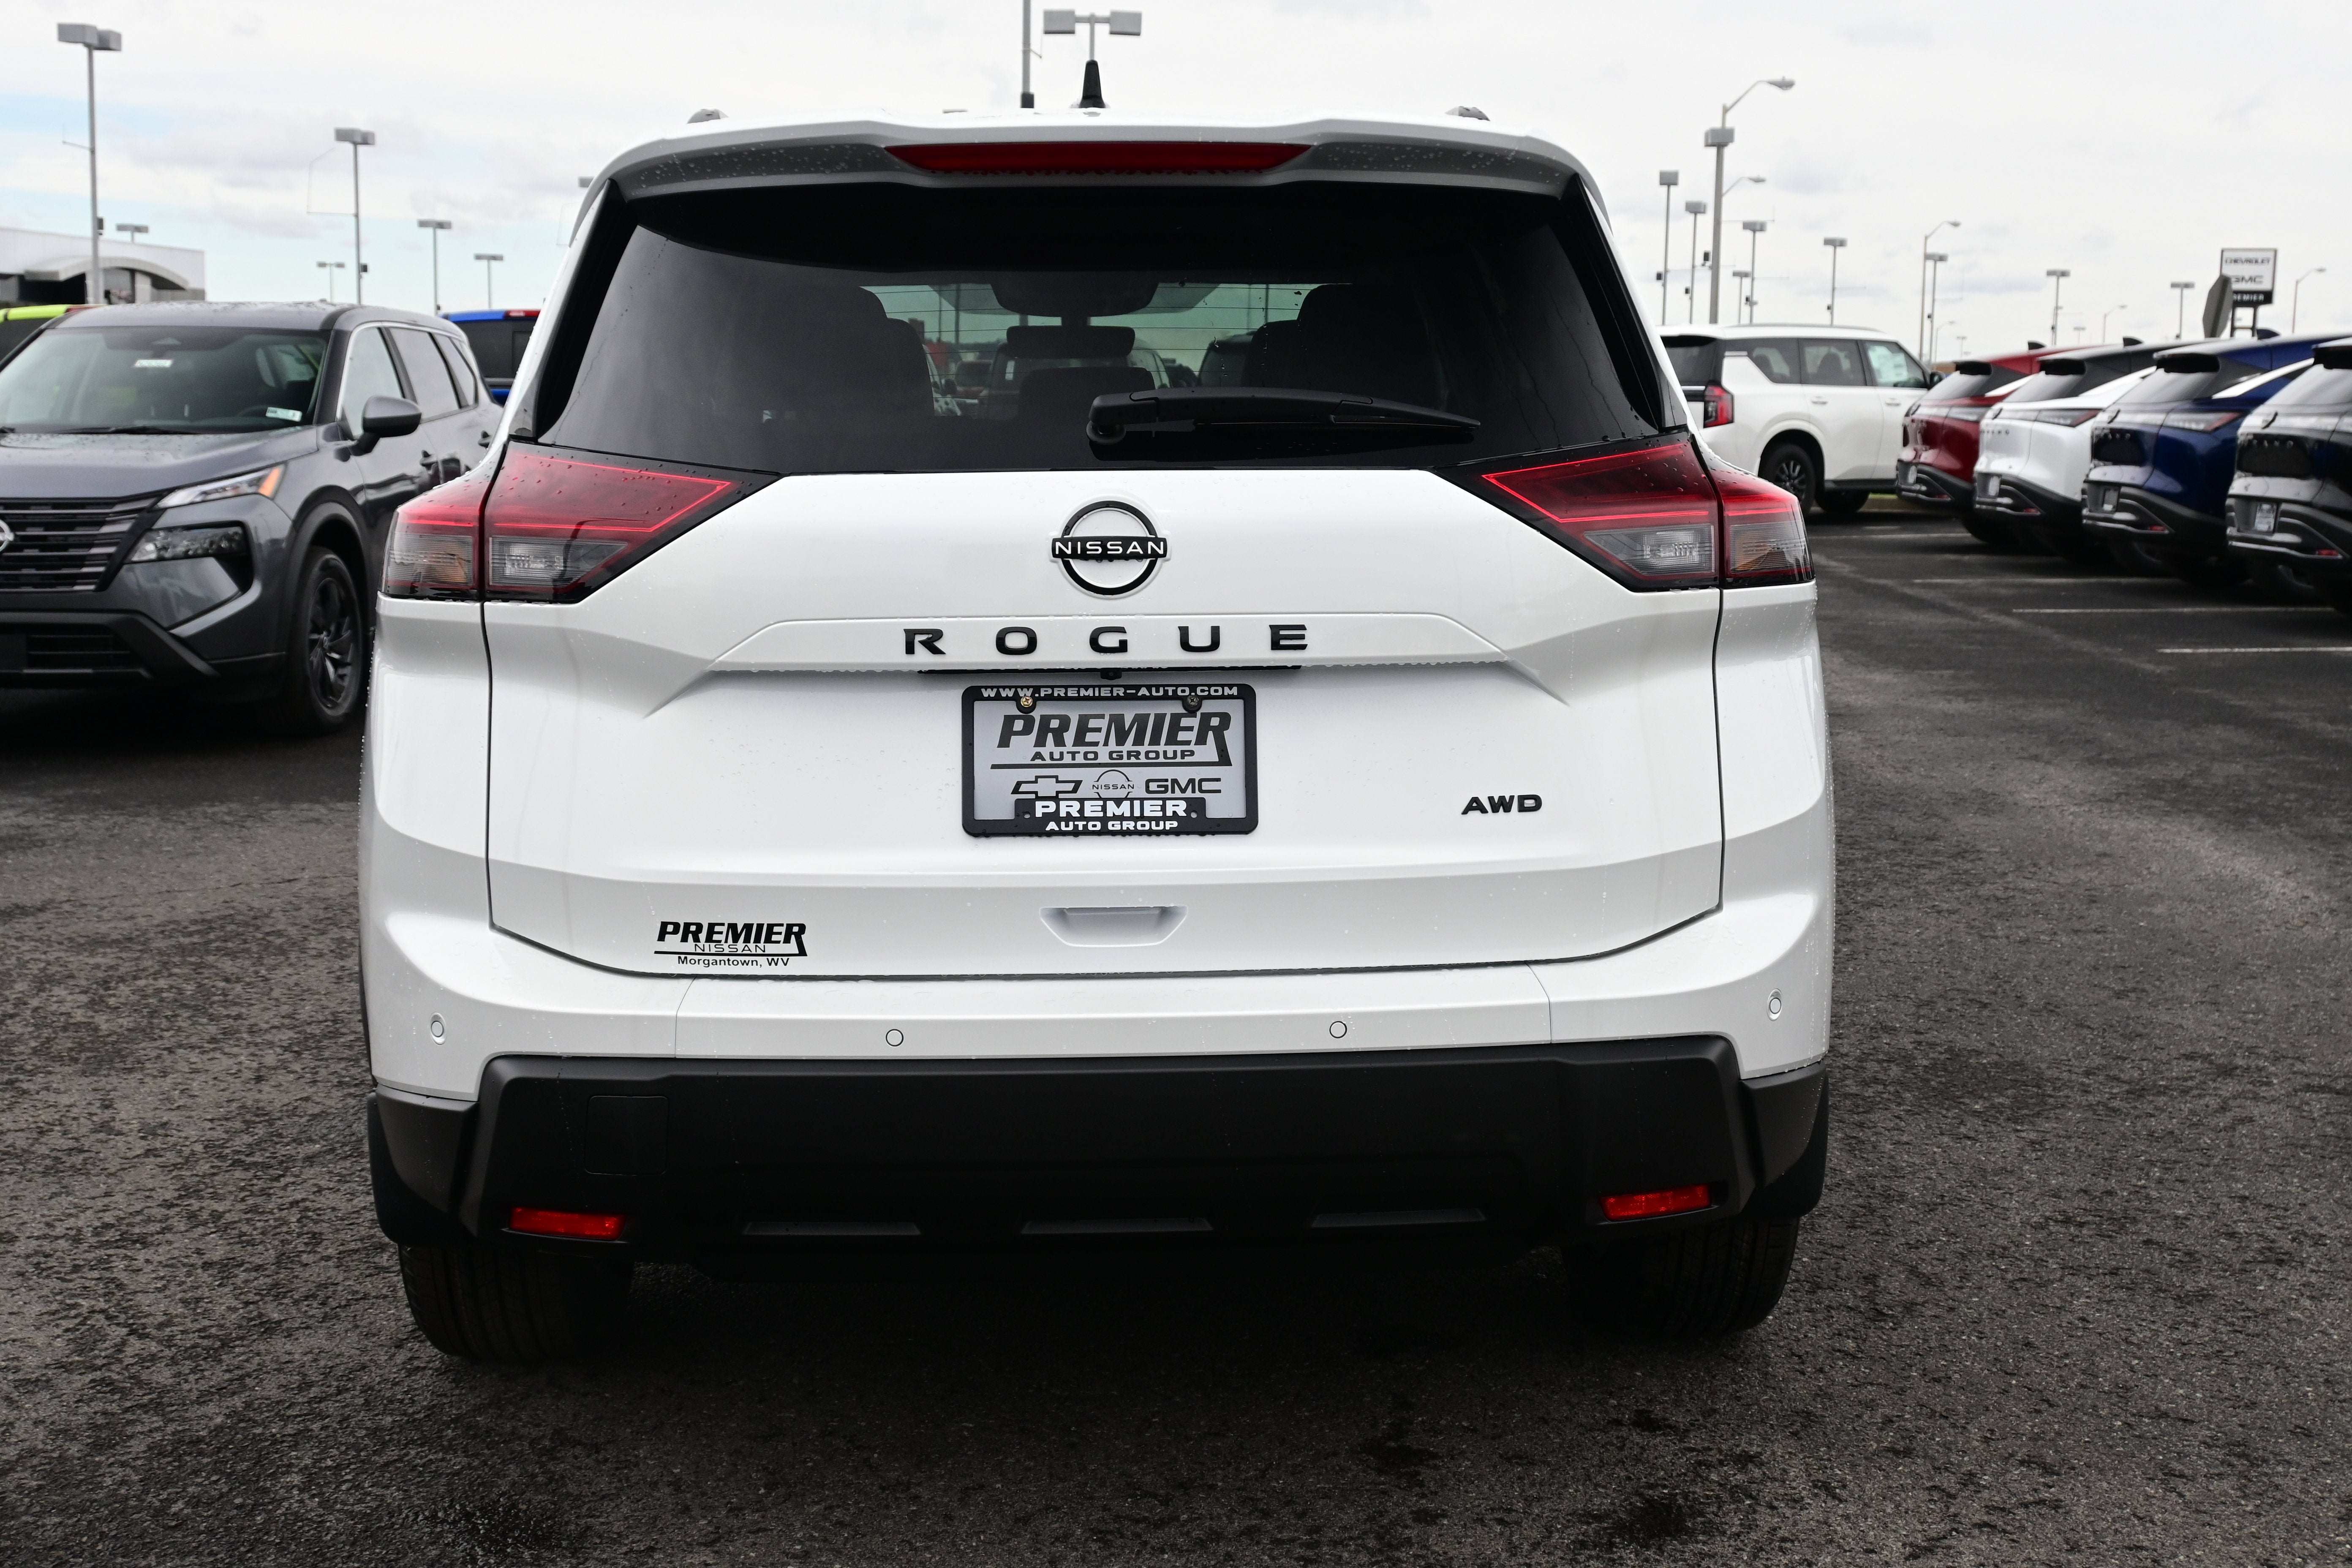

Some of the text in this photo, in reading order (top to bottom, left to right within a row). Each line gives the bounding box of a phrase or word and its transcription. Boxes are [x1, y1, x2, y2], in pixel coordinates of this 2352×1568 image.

[1056, 541, 1164, 554] NISSAN
[904, 624, 1308, 655] ROGUE
[981, 686, 1238, 697] WWW.PREMIER-AUTO.COM
[996, 712, 1232, 749] PREMIER
[1030, 749, 1195, 762] AUTO GROUP
[1145, 778, 1222, 795] GMC
[1035, 800, 1187, 817] PREMIER
[1461, 794, 1542, 815] AWD
[1045, 821, 1179, 831] AUTO GROUP
[656, 921, 806, 945] PREMIER
[694, 943, 766, 953] NISSAN
[678, 956, 790, 968] Morgantown, WV
